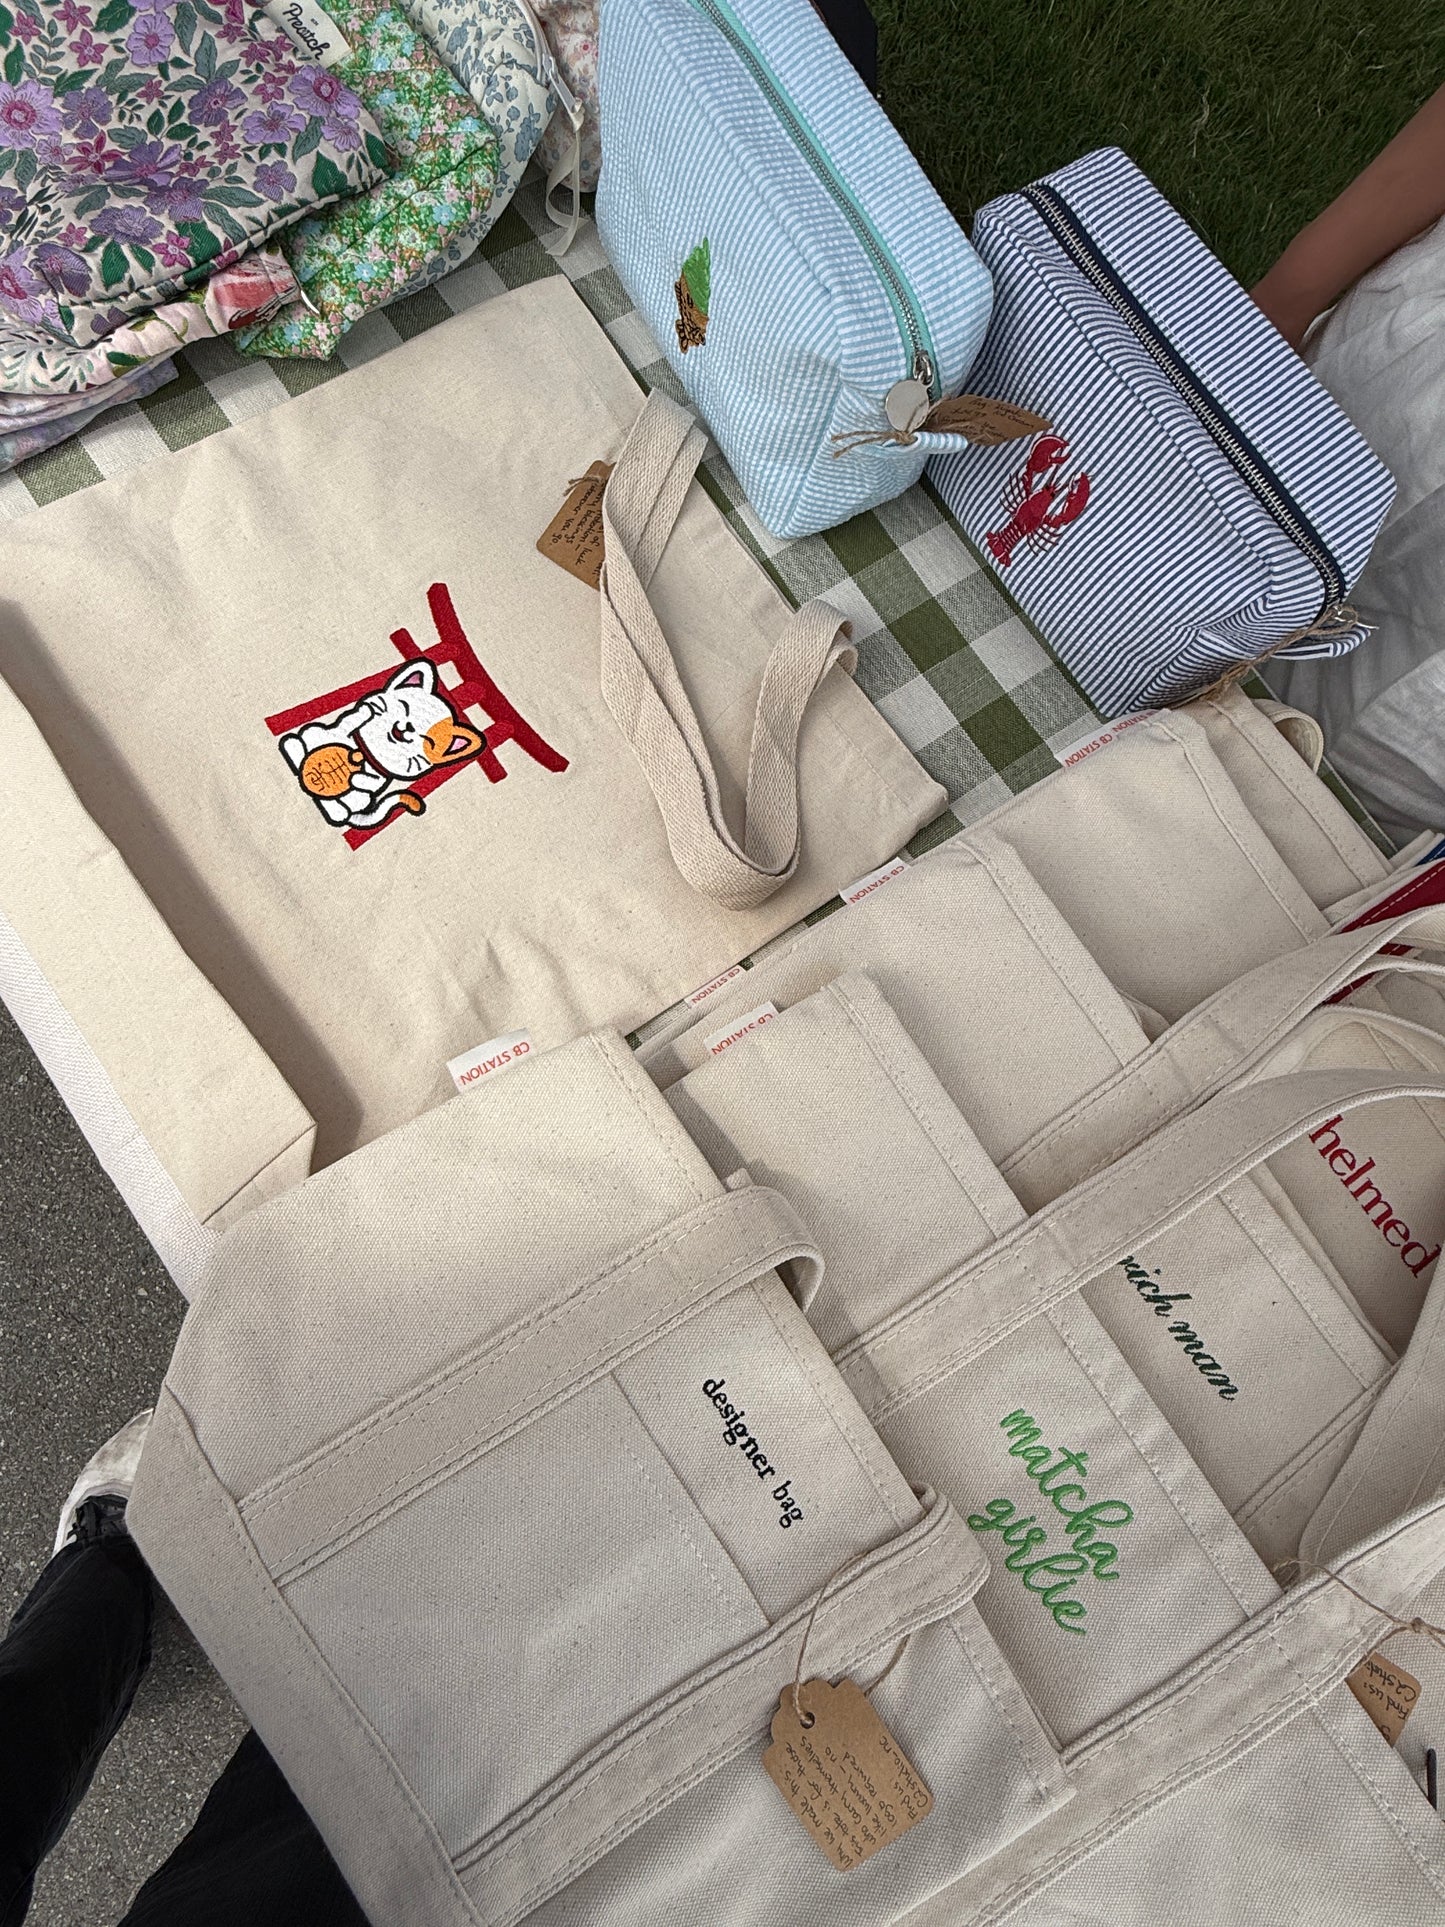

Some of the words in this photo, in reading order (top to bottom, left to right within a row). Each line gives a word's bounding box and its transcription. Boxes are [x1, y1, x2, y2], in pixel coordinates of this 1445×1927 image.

[1100, 733, 1113, 745] CB
[1064, 741, 1101, 767] STATION
[890, 865, 905, 876] CB
[849, 874, 891, 904] STATION
[727, 967, 741, 978] CB
[691, 976, 728, 1004] STATION
[512, 1041, 530, 1057] CB
[460, 1050, 512, 1086] STATION
[1308, 1114, 1443, 1279] helmed
[1167, 1320, 1239, 1402] man
[702, 1379, 776, 1480] designer
[771, 1480, 804, 1529] bag
[1000, 1408, 1134, 1580] matcha
[967, 1498, 1089, 1636] girlie
[1385, 1695, 1409, 1720] Find
[785, 1741, 806, 1777] those
[799, 1735, 838, 1795] themselves
[824, 1746, 837, 1763] no
[806, 1780, 822, 1801] for
[847, 1776, 872, 1814] luxury
[800, 1795, 822, 1828] made
[833, 1812, 849, 1836] tote
[871, 1813, 887, 1837] like
[878, 1800, 897, 1827] logo
[861, 1824, 876, 1845] who
